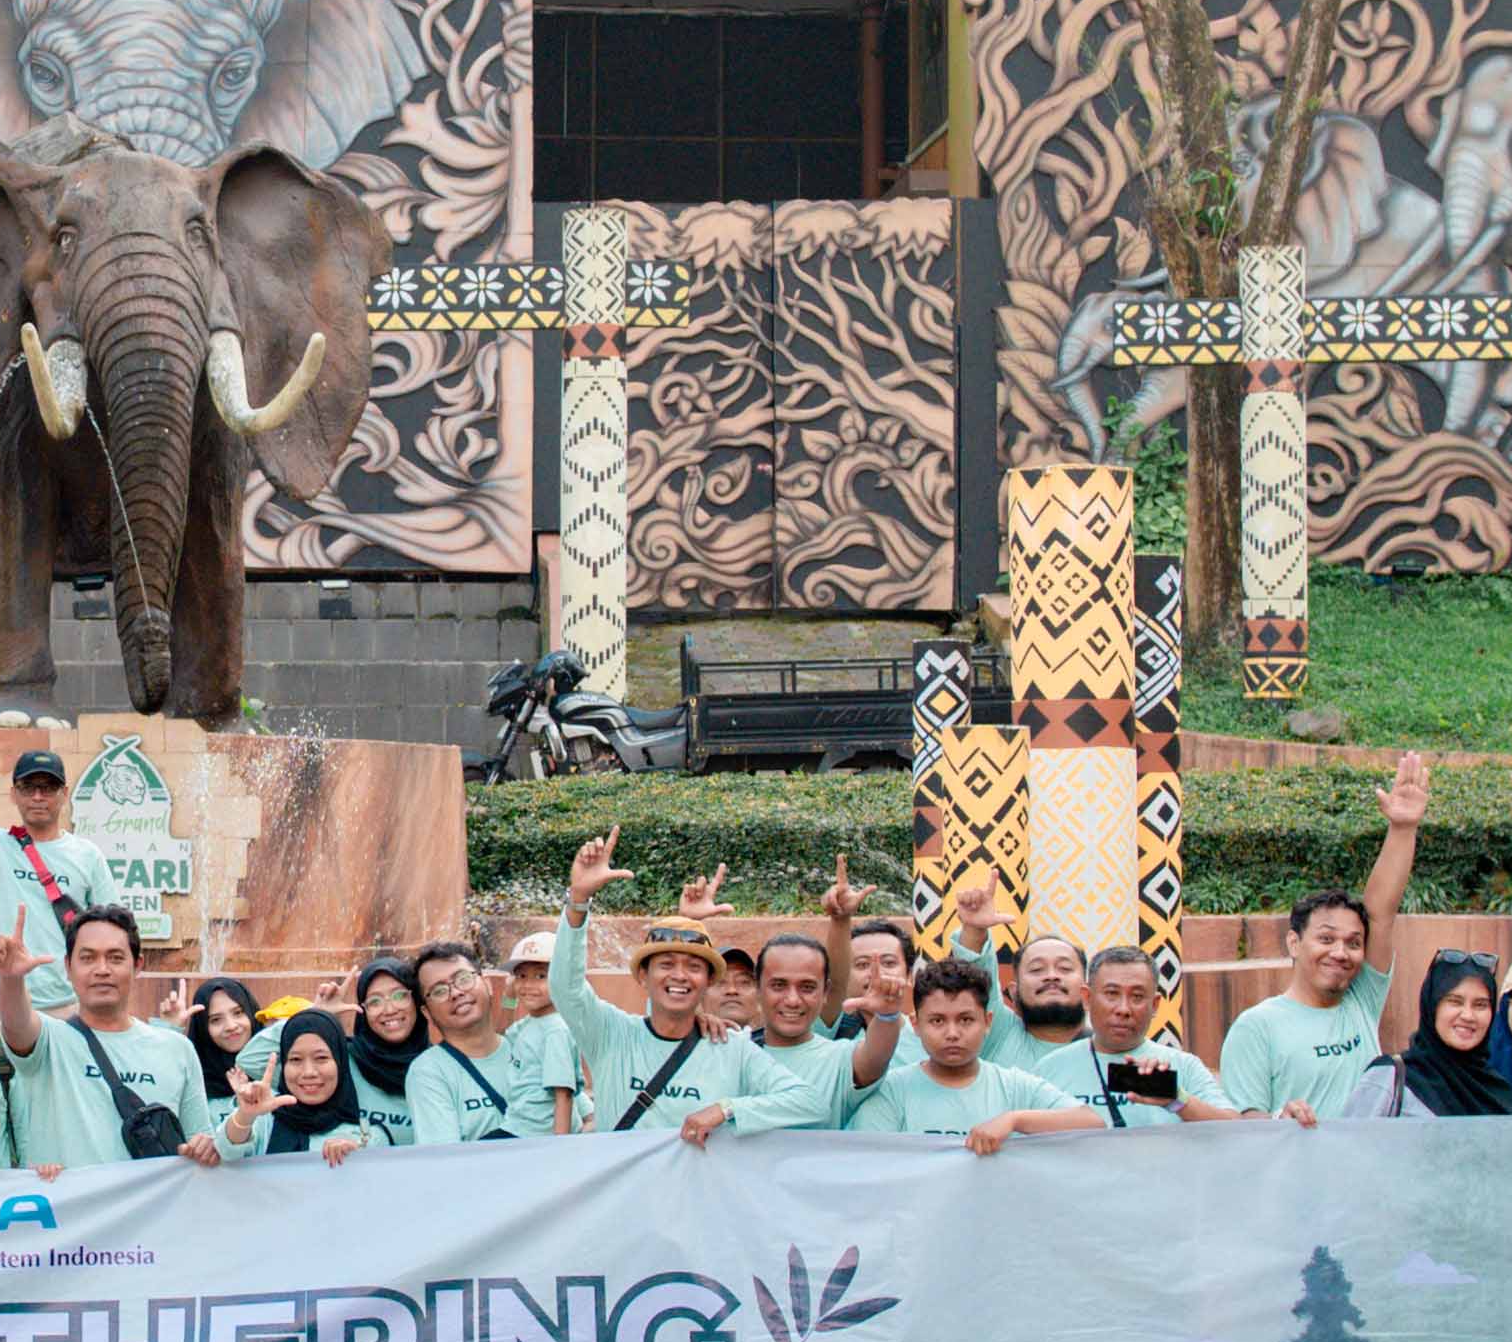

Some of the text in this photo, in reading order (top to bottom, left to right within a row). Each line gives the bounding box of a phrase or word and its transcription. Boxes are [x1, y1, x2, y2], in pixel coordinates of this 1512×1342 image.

[101, 809, 168, 836] Grand
[115, 842, 190, 853] MAN
[107, 859, 190, 890] FARI
[120, 895, 159, 911] GEN
[82, 1064, 156, 1086] DWA
[630, 1076, 701, 1101] DWA
[49, 1244, 156, 1267] Indonesia
